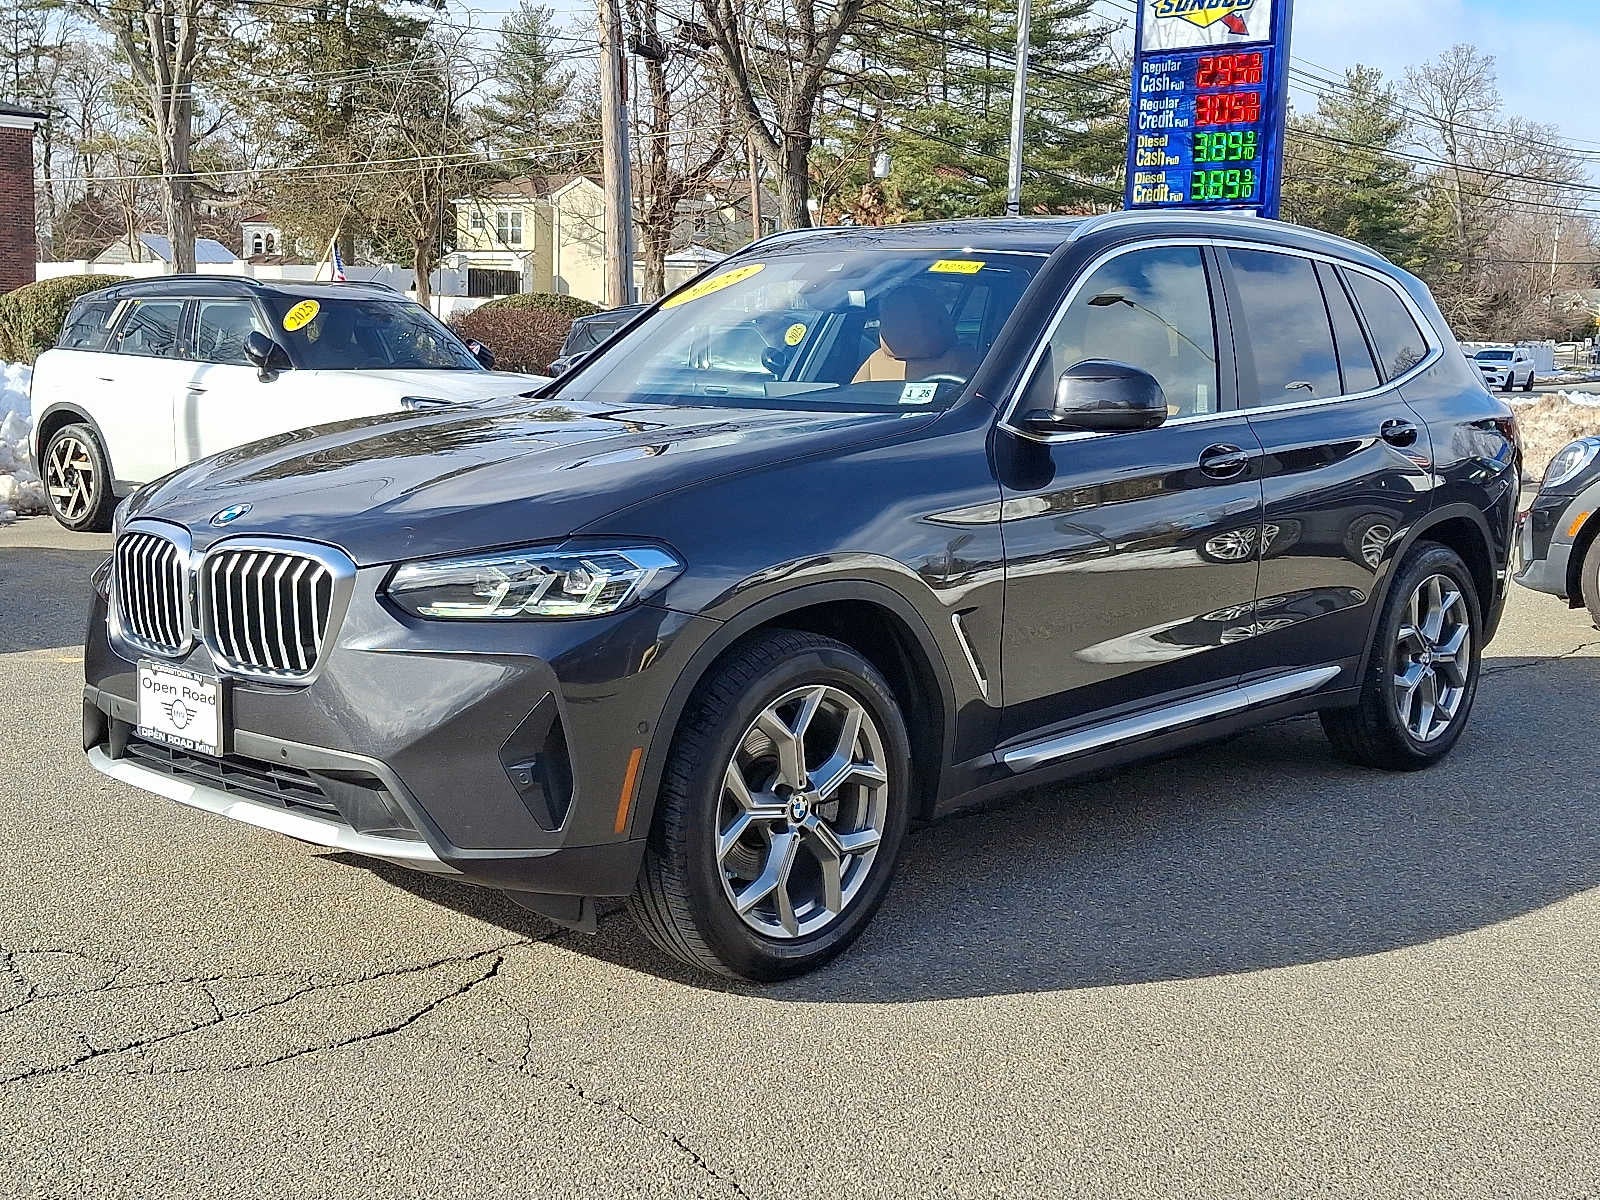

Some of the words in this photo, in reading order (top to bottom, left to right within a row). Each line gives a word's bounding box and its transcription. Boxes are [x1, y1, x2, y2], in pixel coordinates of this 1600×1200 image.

[1143, 60, 1181, 75] Regular
[1141, 74, 1170, 93] Cash
[1140, 98, 1179, 112] Regular
[1139, 110, 1174, 129] Credit
[1138, 134, 1168, 148] Diesel
[1194, 132, 1242, 162] 3.89
[1247, 131, 1254, 143] 9
[1136, 148, 1165, 166] Cash
[1135, 171, 1165, 185] Diesel
[1191, 169, 1240, 200] 3.89
[1245, 169, 1251, 181] 9
[1134, 183, 1169, 203] Credit
[289, 302, 314, 326] 2025
[142, 677, 177, 695] Open
[182, 686, 216, 706] Road
[141, 727, 166, 742] OPEN
[168, 734, 194, 749] ROAD
[195, 743, 215, 756] MINI
